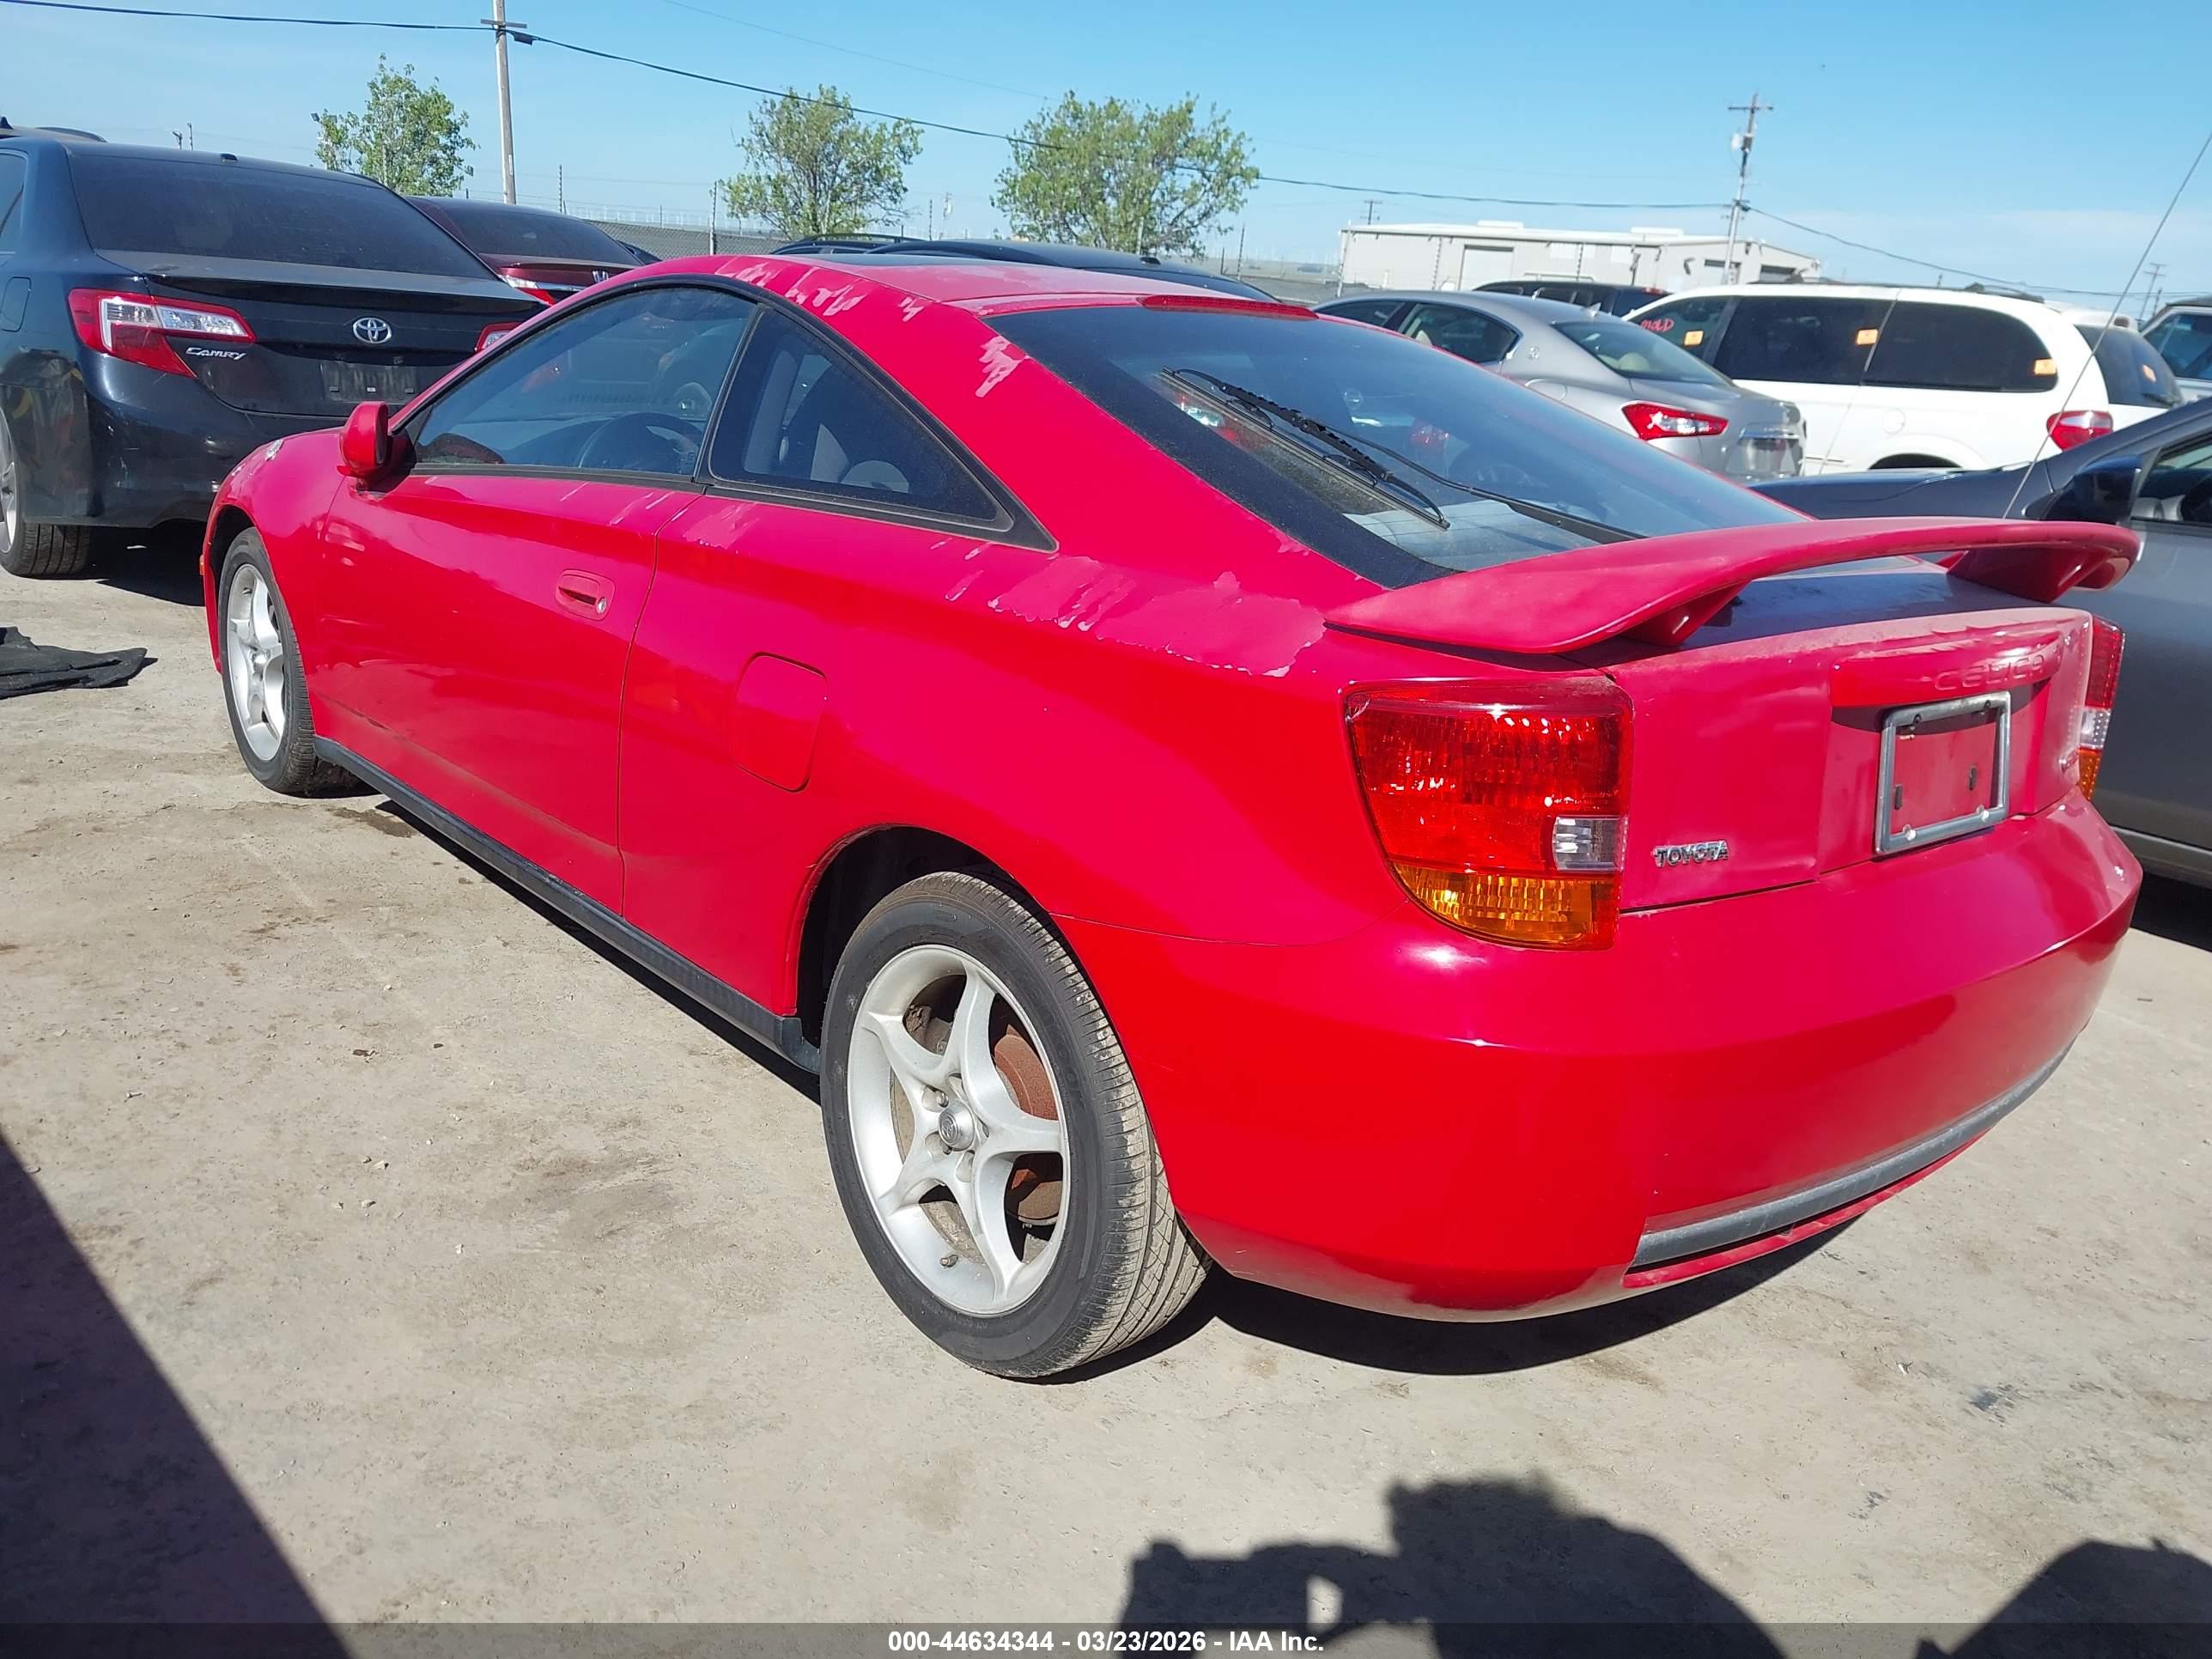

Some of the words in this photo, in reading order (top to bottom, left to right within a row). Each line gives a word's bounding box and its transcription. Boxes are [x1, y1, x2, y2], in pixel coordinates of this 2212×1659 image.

[185, 346, 246, 361] CAMRY
[1934, 654, 2045, 690] CELICA
[1653, 840, 1729, 867] TOYOTA
